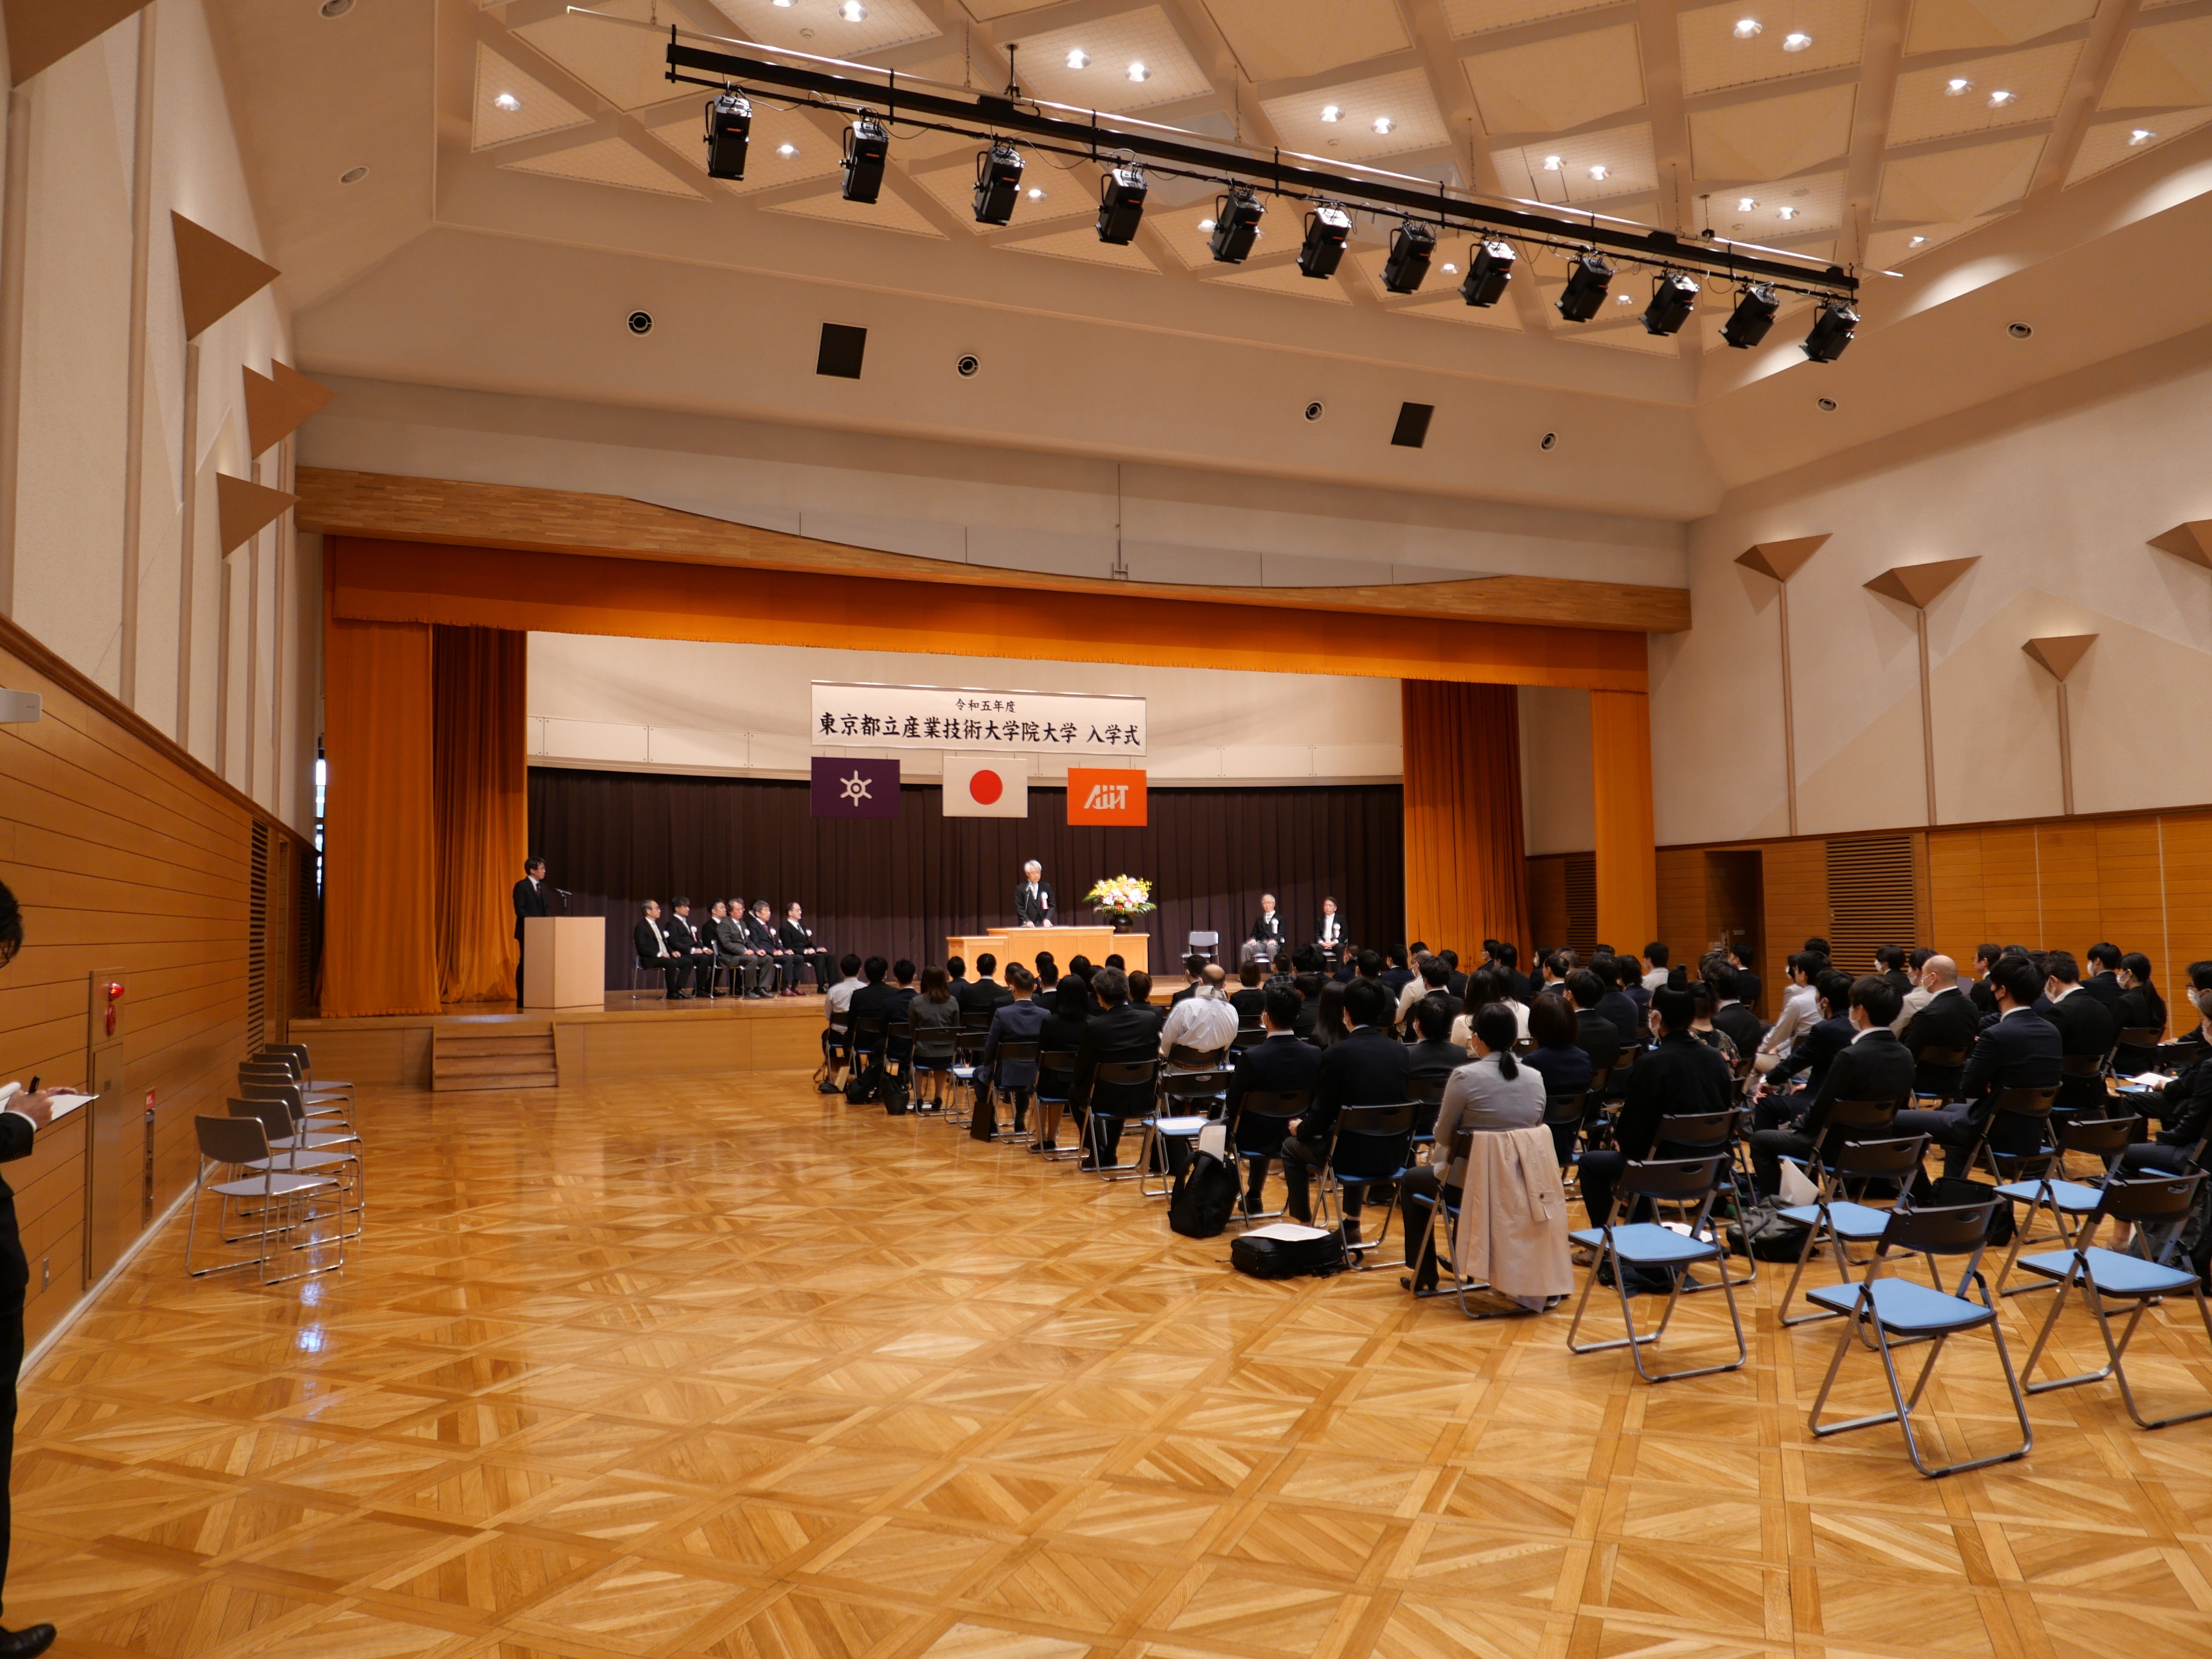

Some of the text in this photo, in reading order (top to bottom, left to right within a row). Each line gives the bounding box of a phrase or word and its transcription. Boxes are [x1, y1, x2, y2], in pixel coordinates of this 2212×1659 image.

[955, 698, 1016, 713] 令和五年度
[819, 712, 1141, 746] 東京都立産業技術大学院大学 入学式
